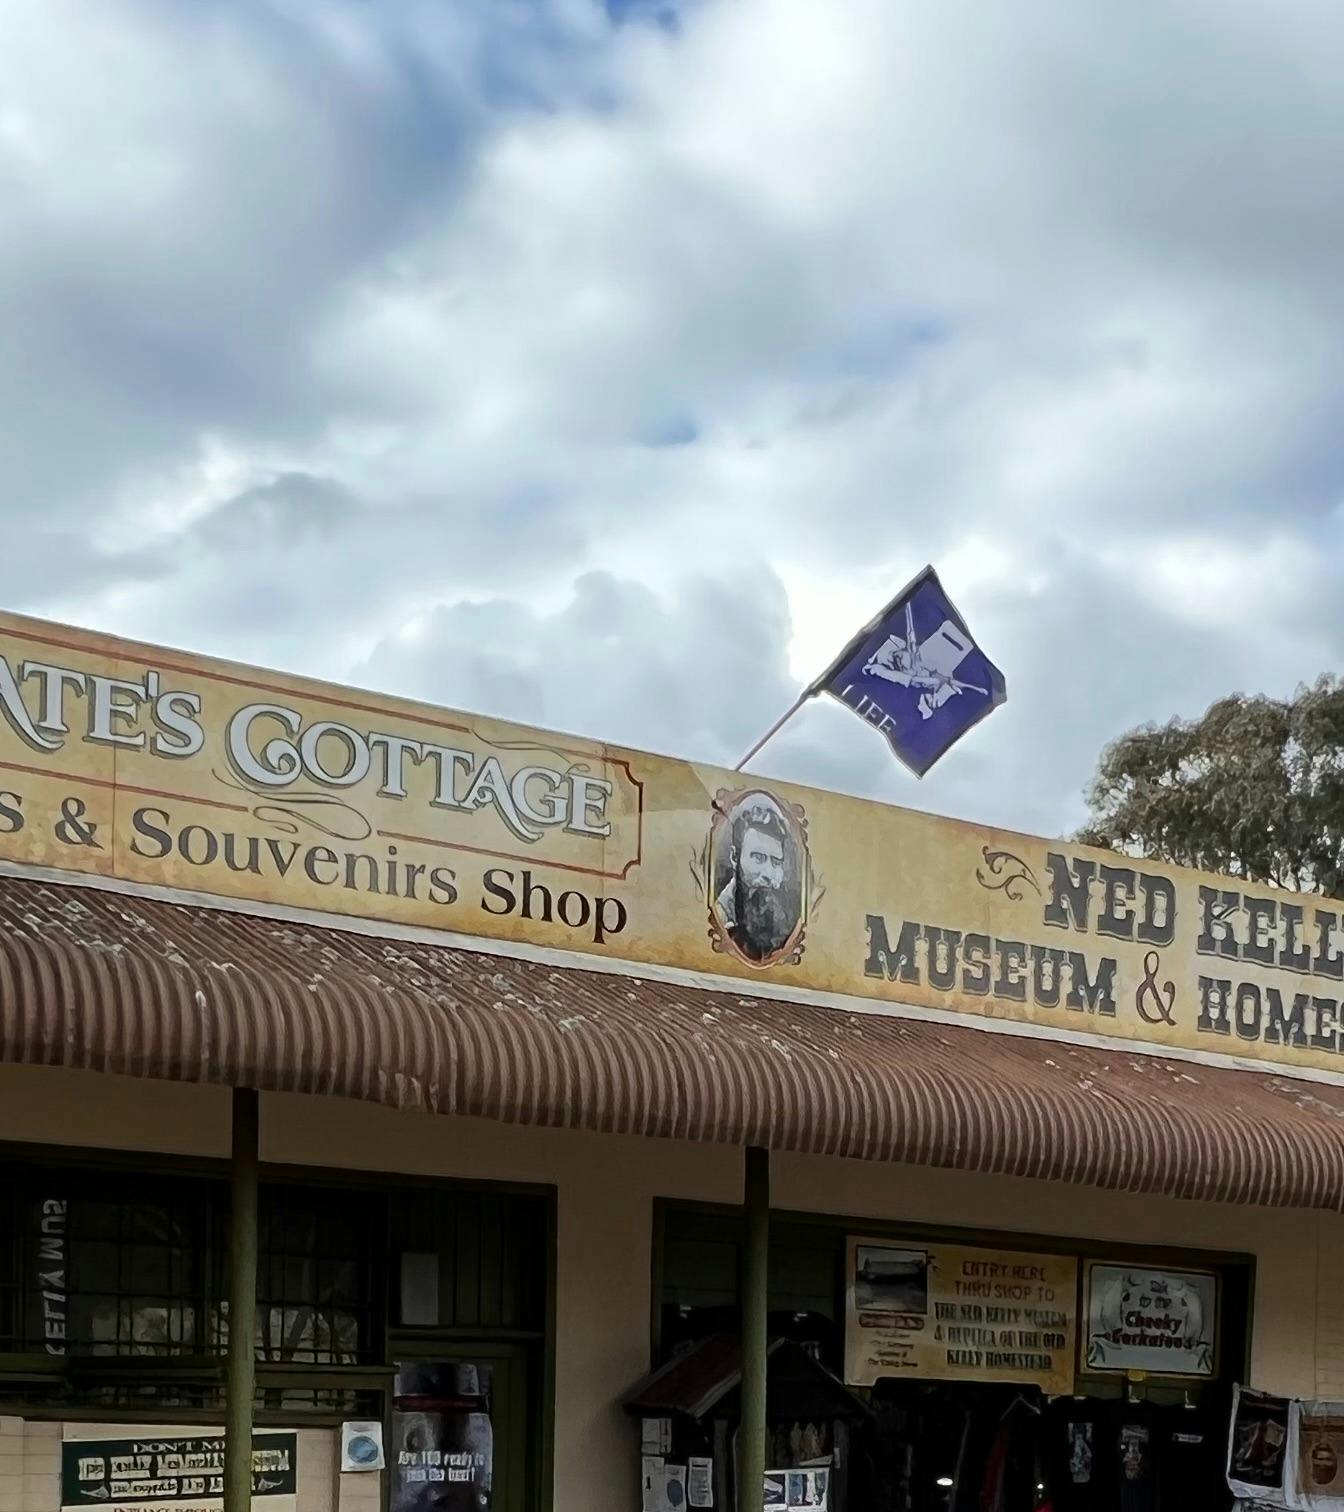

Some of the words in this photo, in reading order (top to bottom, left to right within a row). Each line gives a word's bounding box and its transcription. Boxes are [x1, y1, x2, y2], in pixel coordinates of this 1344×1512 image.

[225, 702, 613, 843] COTTAGE
[53, 796, 104, 851] &
[129, 807, 459, 905] Souvenirs
[480, 868, 628, 944] Shop
[1044, 852, 1178, 947] NED
[863, 914, 1118, 1017] MUSEUM
[1136, 950, 1177, 1026] &
[962, 1260, 1009, 1277] ENTRY
[1012, 1266, 1047, 1281] HERE
[994, 1284, 1033, 1300] SHOP
[1038, 1287, 1056, 1302] TO
[986, 1352, 1052, 1370] HOMESTEAD
